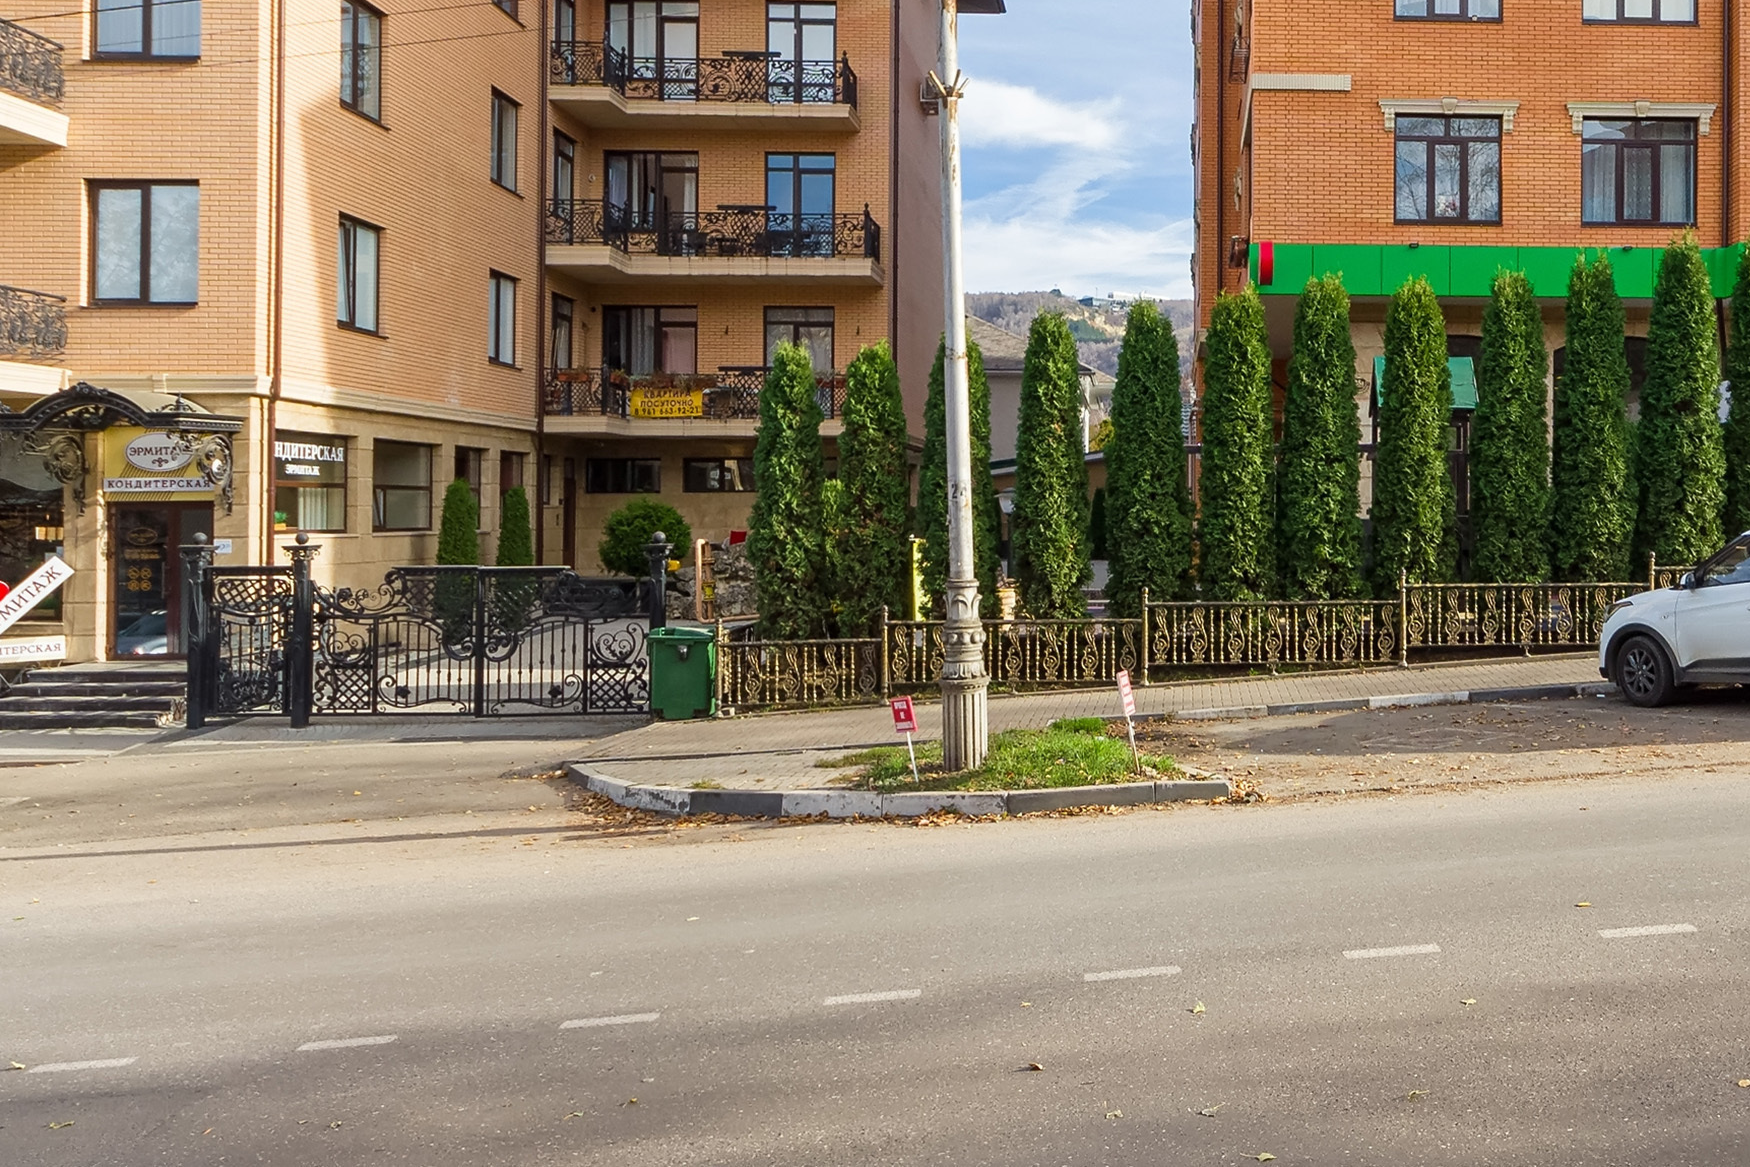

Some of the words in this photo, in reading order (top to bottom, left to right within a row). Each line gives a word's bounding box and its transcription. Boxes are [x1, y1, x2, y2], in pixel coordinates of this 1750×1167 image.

[643, 390, 692, 399] КВАРТИРА
[640, 399, 694, 408] ПОСУТОЧНО
[129, 446, 192, 456] ЭРМИТА
[107, 479, 211, 489] КОНДИТЕРСКАЯ
[0, 566, 62, 621] МИТАЖ
